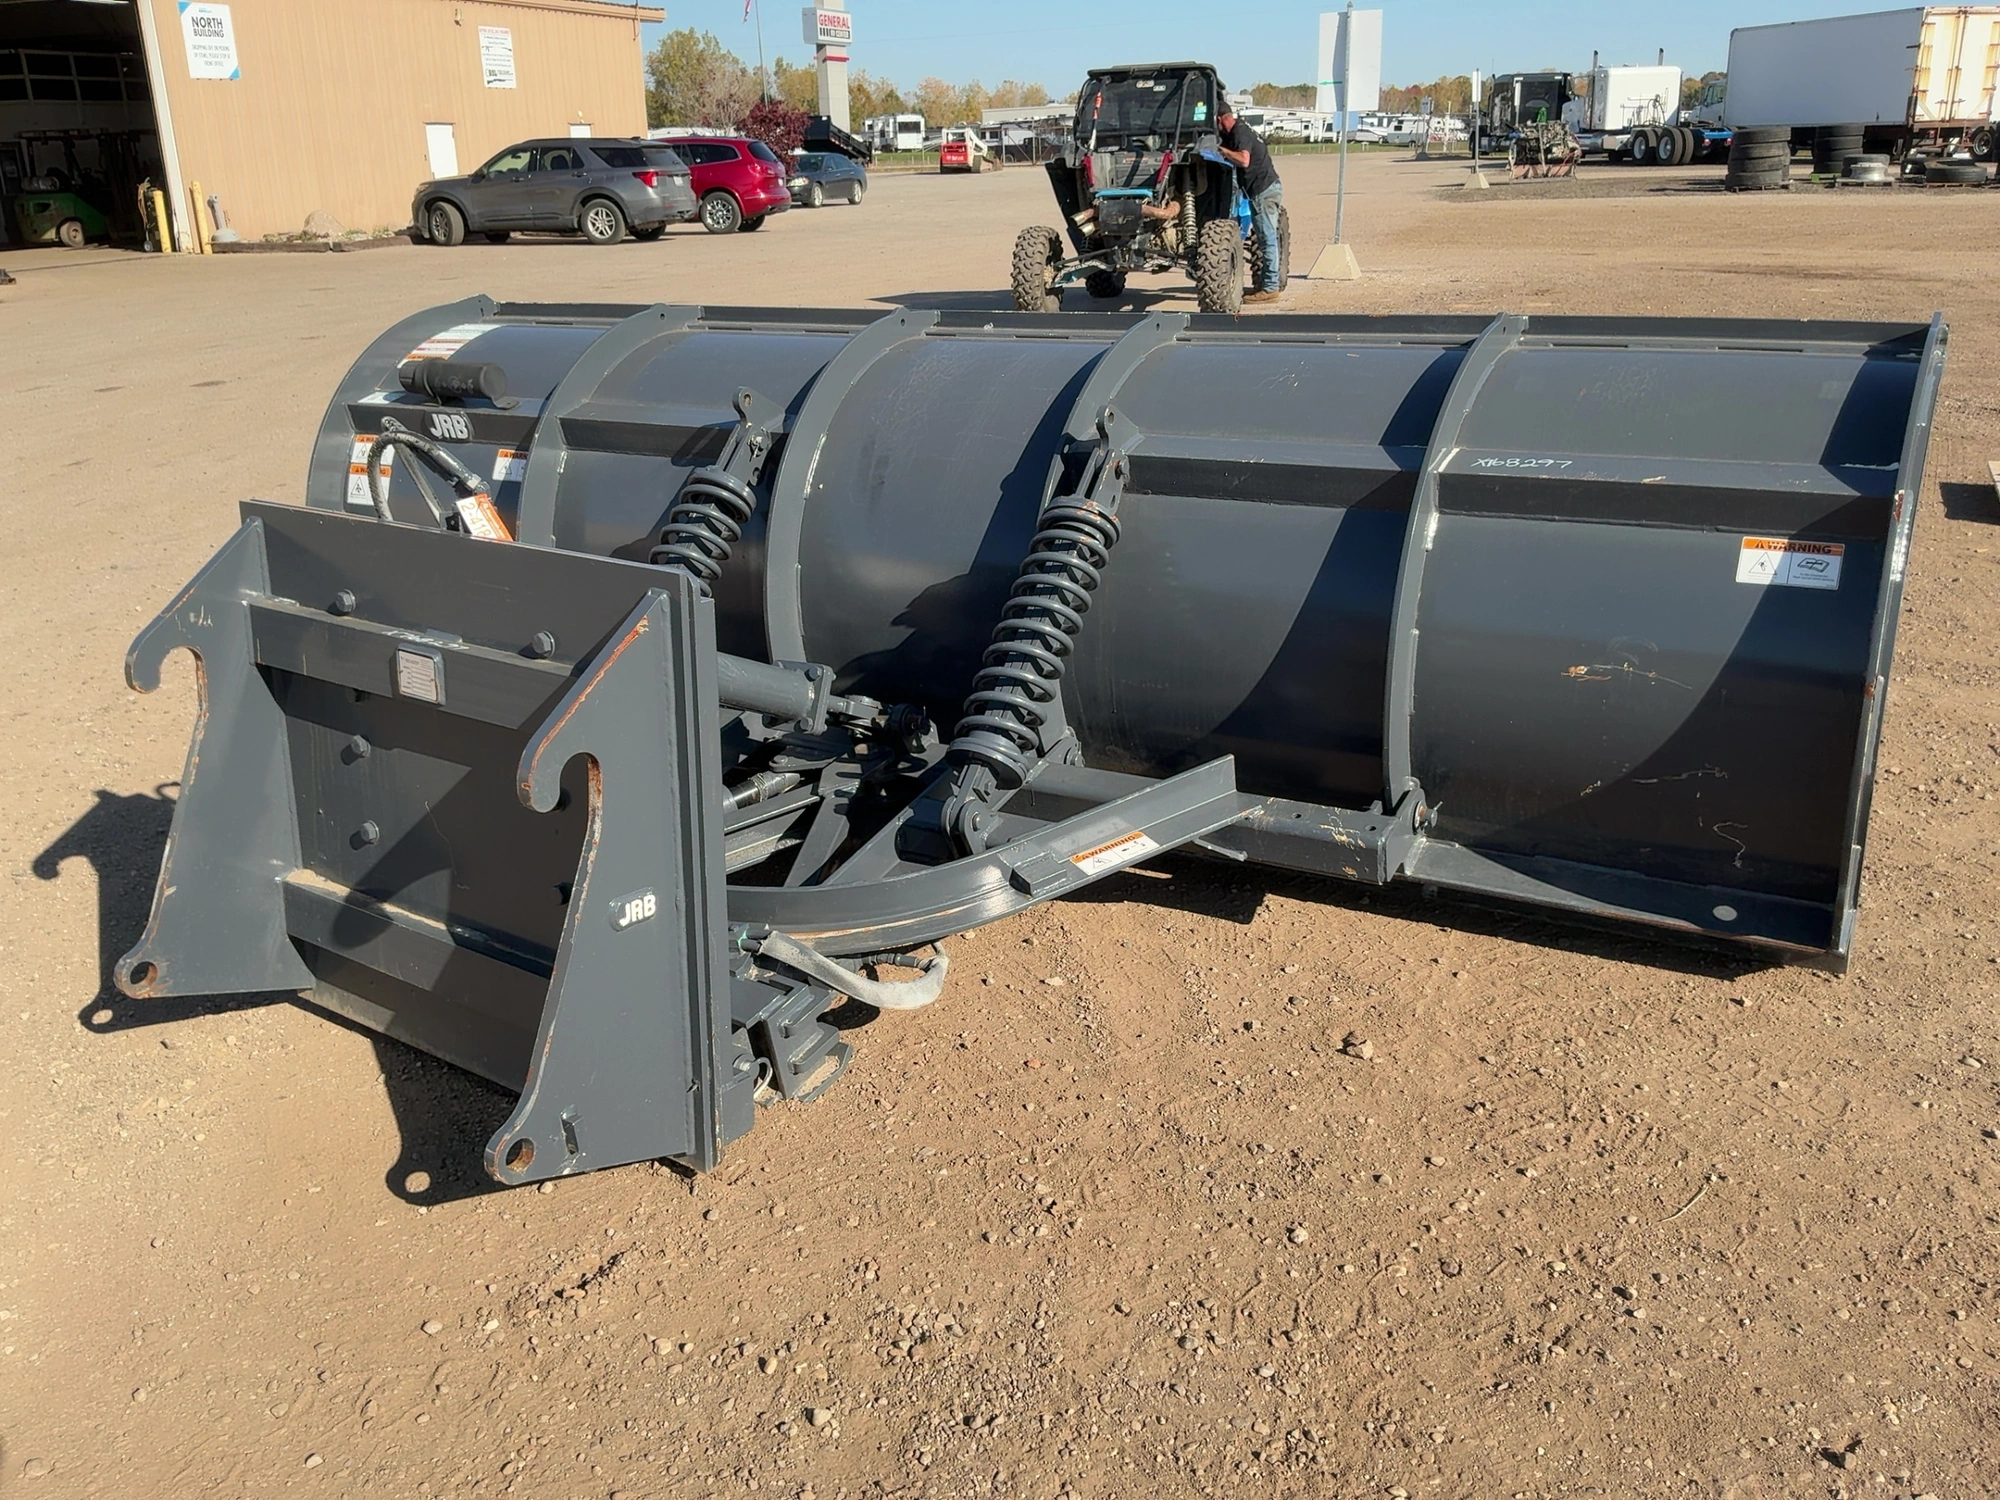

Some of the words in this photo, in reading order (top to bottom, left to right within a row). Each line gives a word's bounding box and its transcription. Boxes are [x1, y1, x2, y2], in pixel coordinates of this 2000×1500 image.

[191, 16, 224, 29] NORTH
[819, 14, 850, 29] GENERAL
[193, 28, 225, 38] BUILDING
[430, 413, 469, 439] JRB
[1767, 541, 1832, 554] WARNING
[1087, 835, 1136, 857] WARNING
[619, 894, 656, 927] JRB
